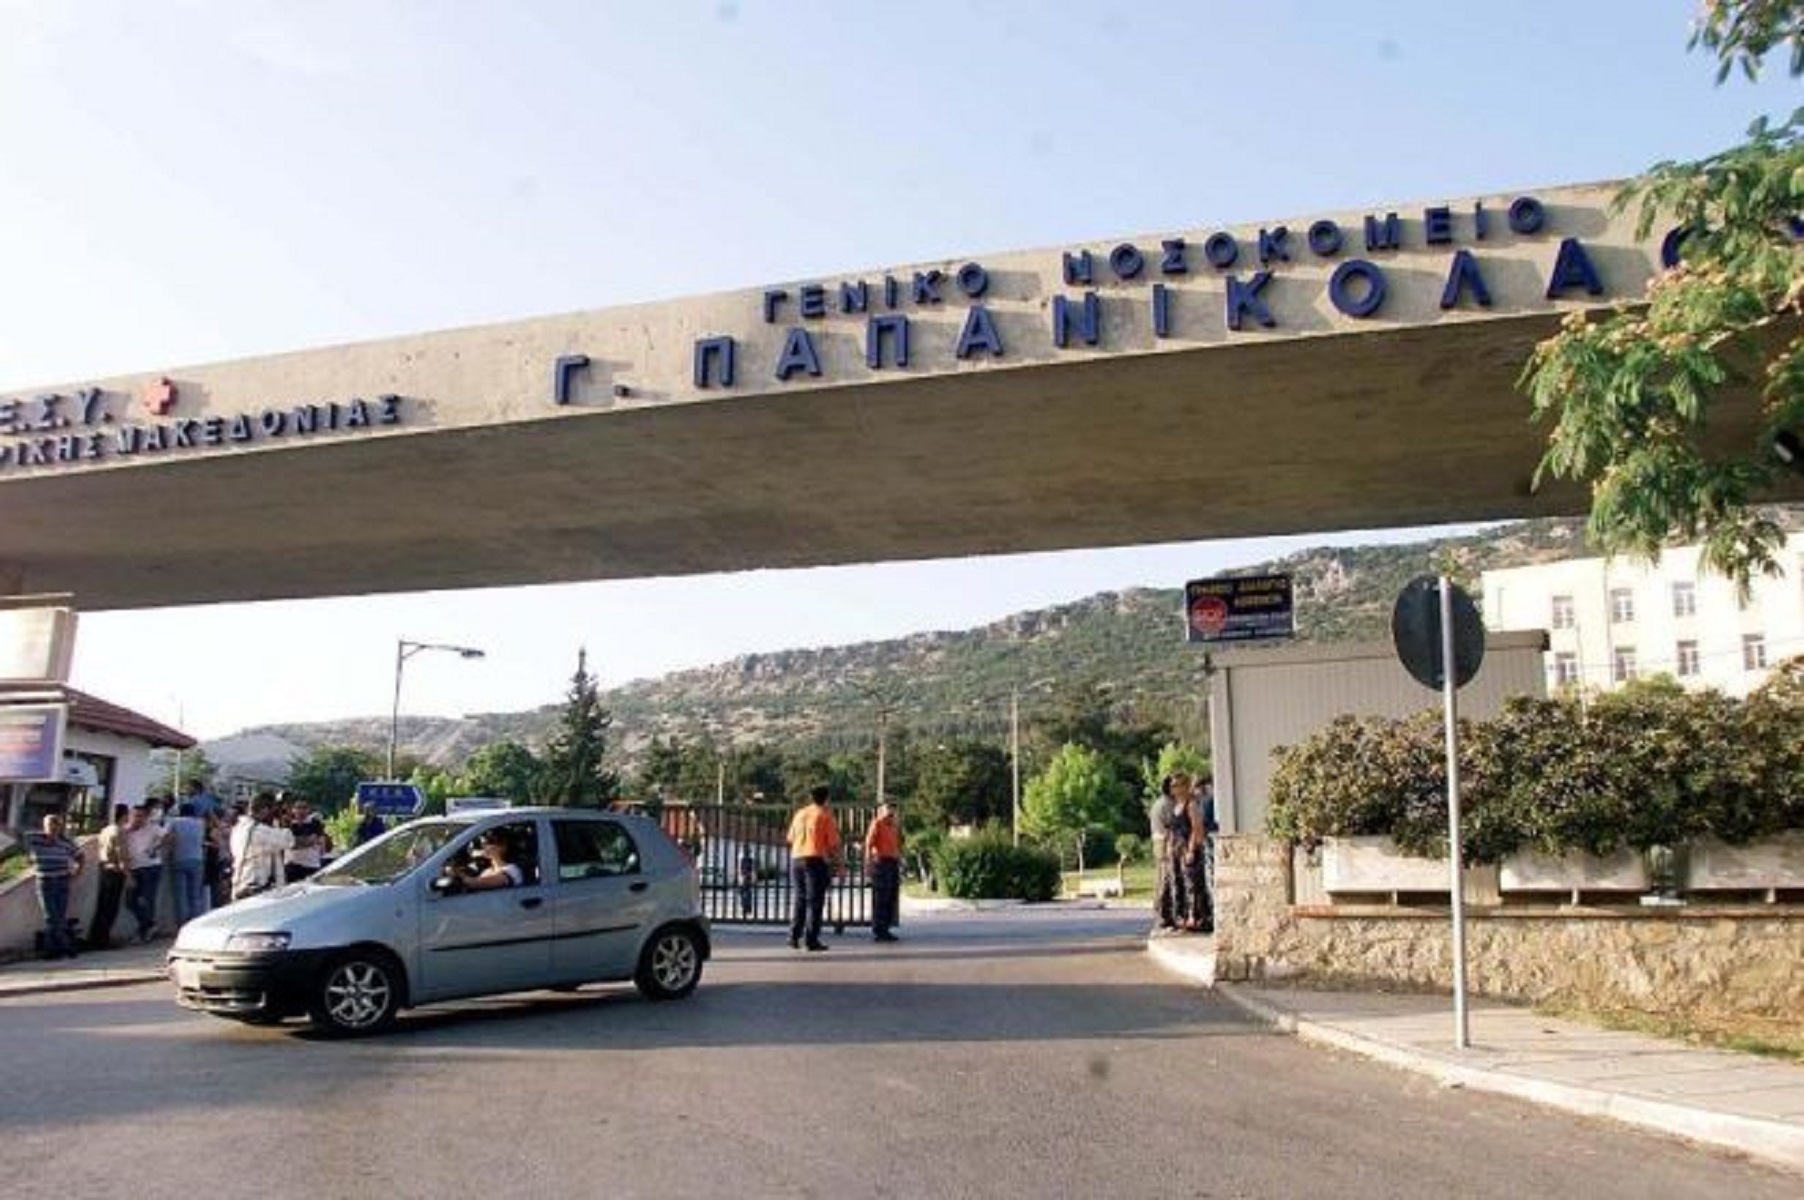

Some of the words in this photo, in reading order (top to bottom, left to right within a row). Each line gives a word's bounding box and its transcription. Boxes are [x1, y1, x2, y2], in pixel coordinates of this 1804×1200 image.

[693, 214, 1804, 389] ΠΑΠΑΝΙΚΟΛΑ
[764, 261, 989, 323] ΓΕΝΙΚΟ
[1062, 196, 1546, 286] ΝΟΣΟΚΟΜΕΙΟ
[117, 395, 402, 455] ΜΑΚΕΔΟΝΙΑΣ
